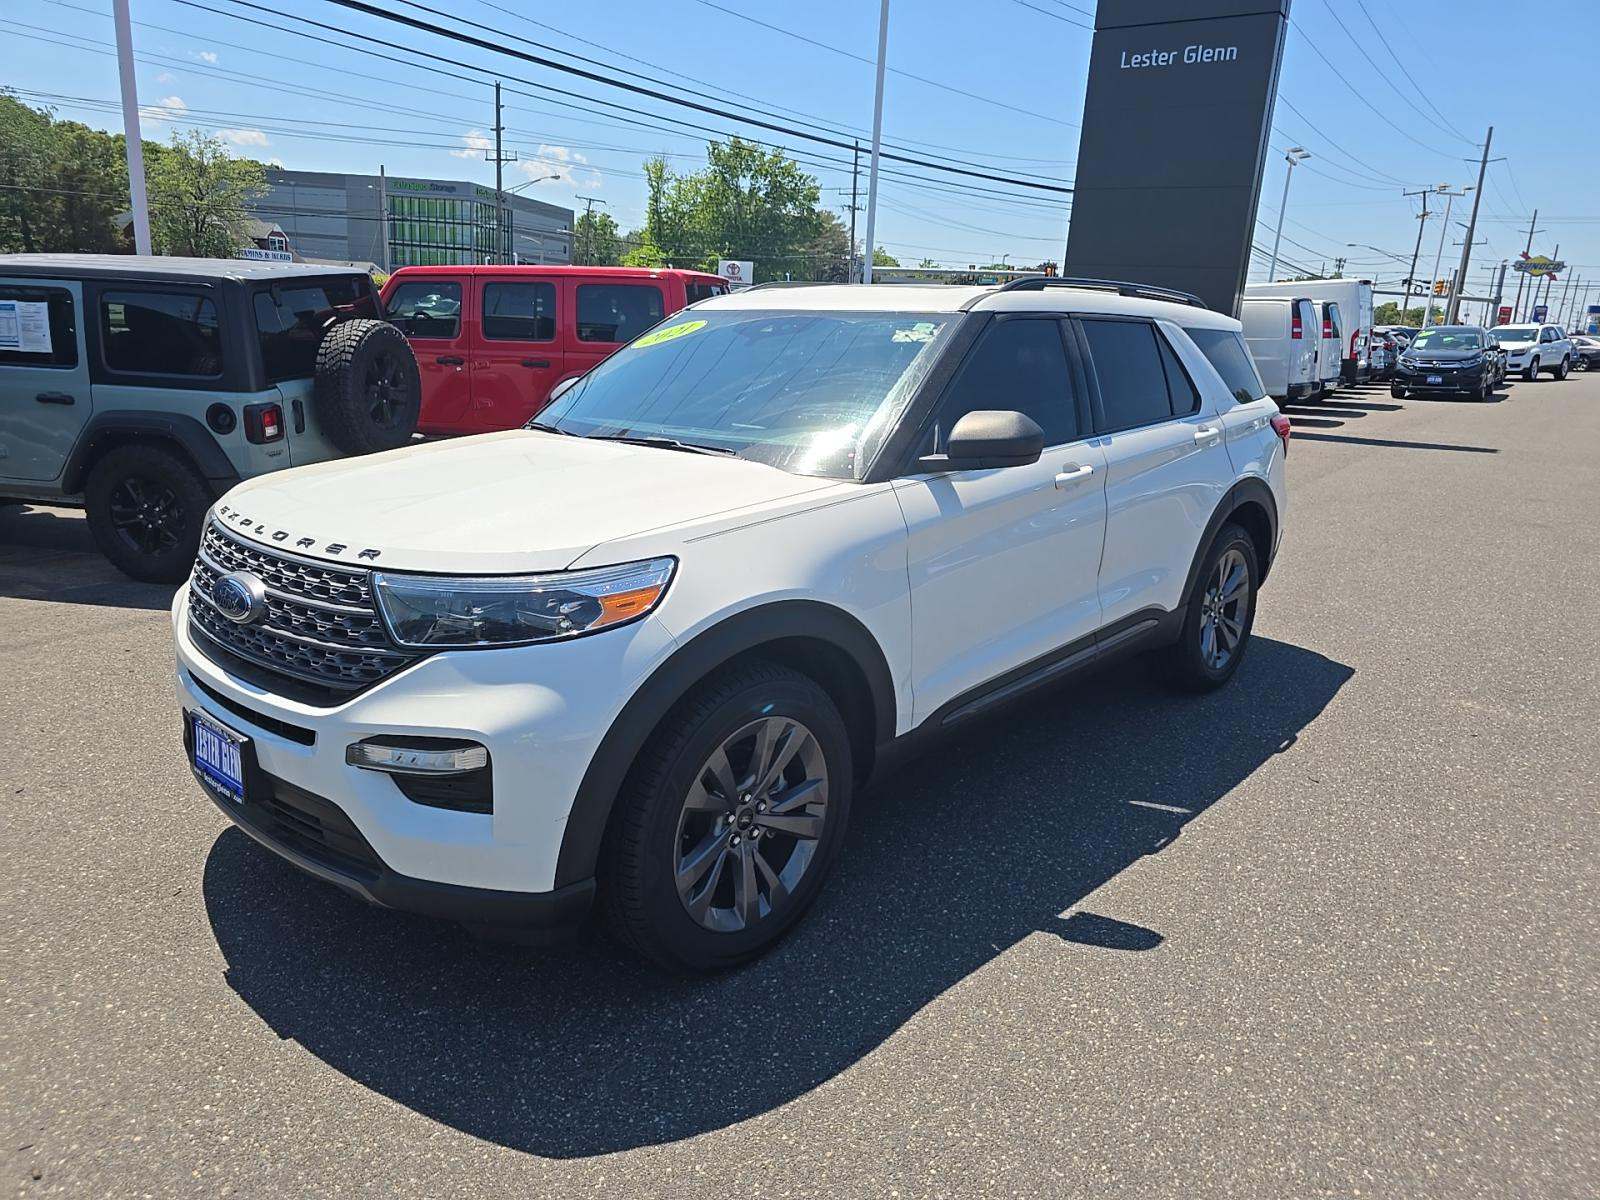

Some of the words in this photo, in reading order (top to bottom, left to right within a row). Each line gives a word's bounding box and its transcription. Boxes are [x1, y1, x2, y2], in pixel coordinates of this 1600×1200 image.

[1120, 50, 1177, 69] Lester
[1184, 45, 1238, 64] Glenn
[264, 251, 270, 259] &
[1514, 260, 1563, 272] SUNOCO
[219, 505, 382, 561] EXPLORER
[195, 725, 220, 769] LESTER
[221, 740, 243, 784] GLENN
